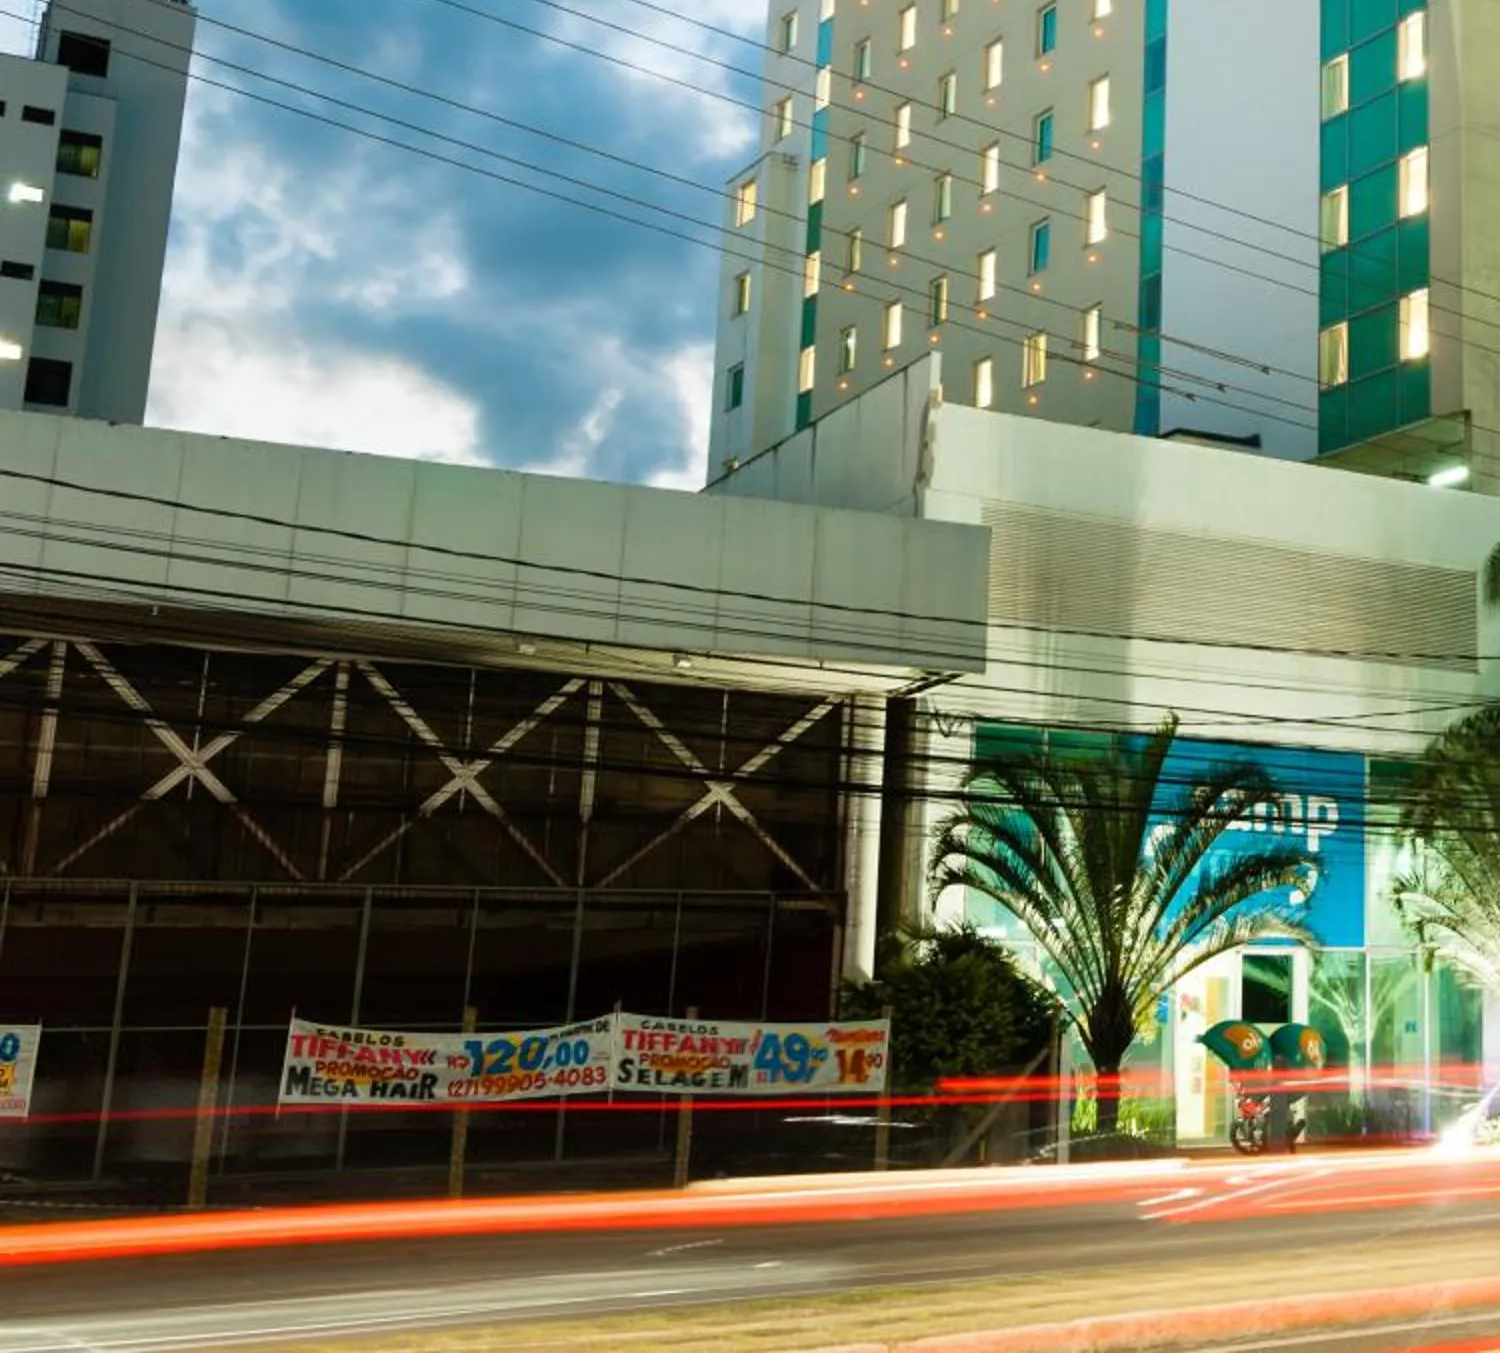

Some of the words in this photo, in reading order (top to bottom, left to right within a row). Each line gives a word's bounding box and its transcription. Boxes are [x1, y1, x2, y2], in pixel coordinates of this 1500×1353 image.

[316, 1029, 406, 1047] CABELOS
[464, 1037, 590, 1077] 120,00
[617, 1057, 749, 1088] SELAGEM
[286, 1065, 359, 1097] MEGA
[370, 1072, 438, 1099] HAIR
